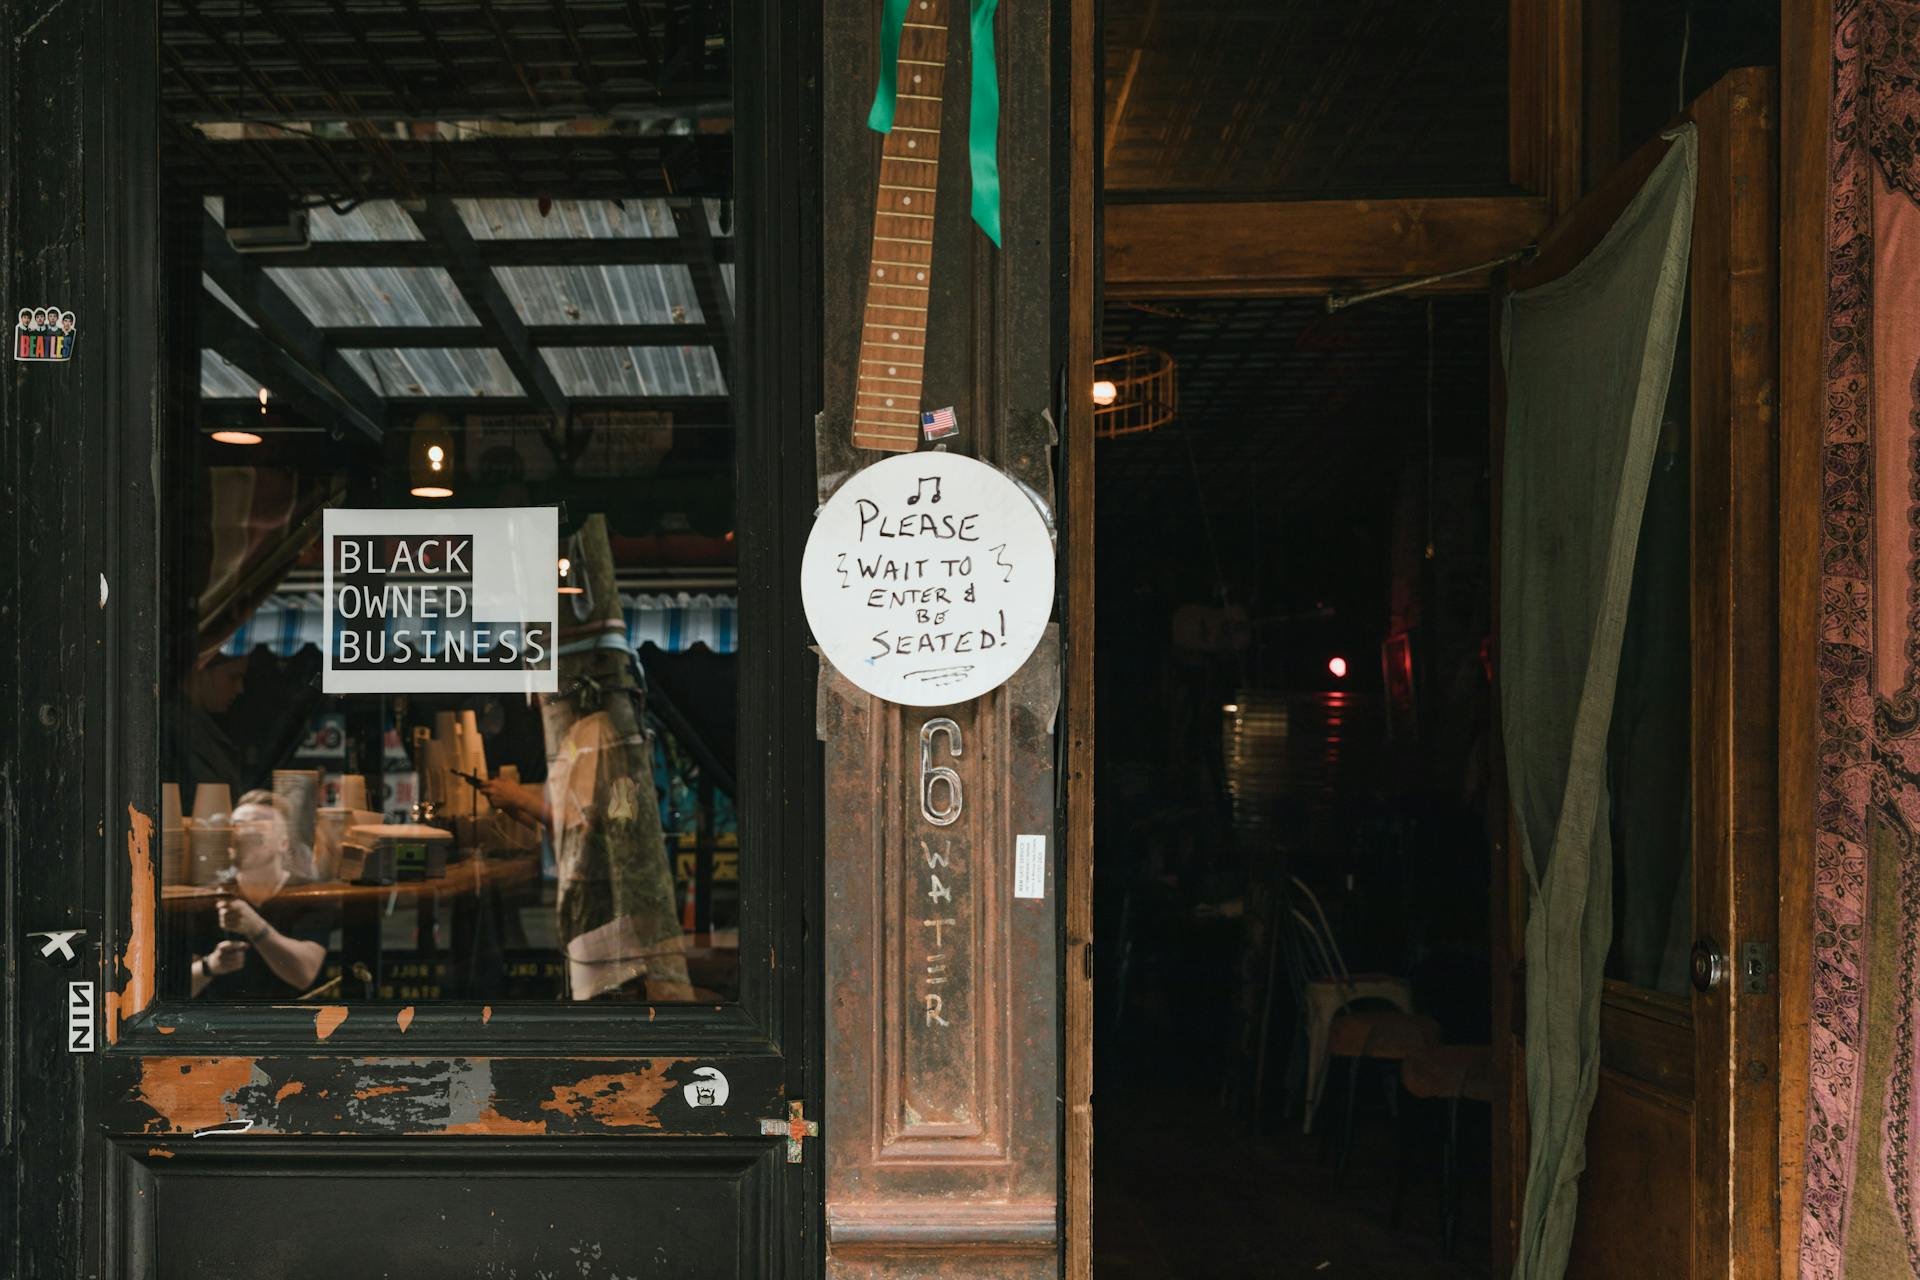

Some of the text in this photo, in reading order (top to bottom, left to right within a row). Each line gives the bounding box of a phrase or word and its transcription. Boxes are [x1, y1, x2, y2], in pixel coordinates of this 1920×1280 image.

[20, 335, 73, 358] BEATLES
[856, 499, 980, 542] PLEASE
[340, 540, 470, 574] BLACK
[857, 554, 973, 581] WAIT TO
[338, 585, 468, 619] OWNED
[867, 587, 952, 609] ENTER
[916, 609, 949, 625] BE
[339, 629, 545, 664] BUSINESS
[870, 609, 1008, 660] SEATED!
[919, 717, 963, 826] 6
